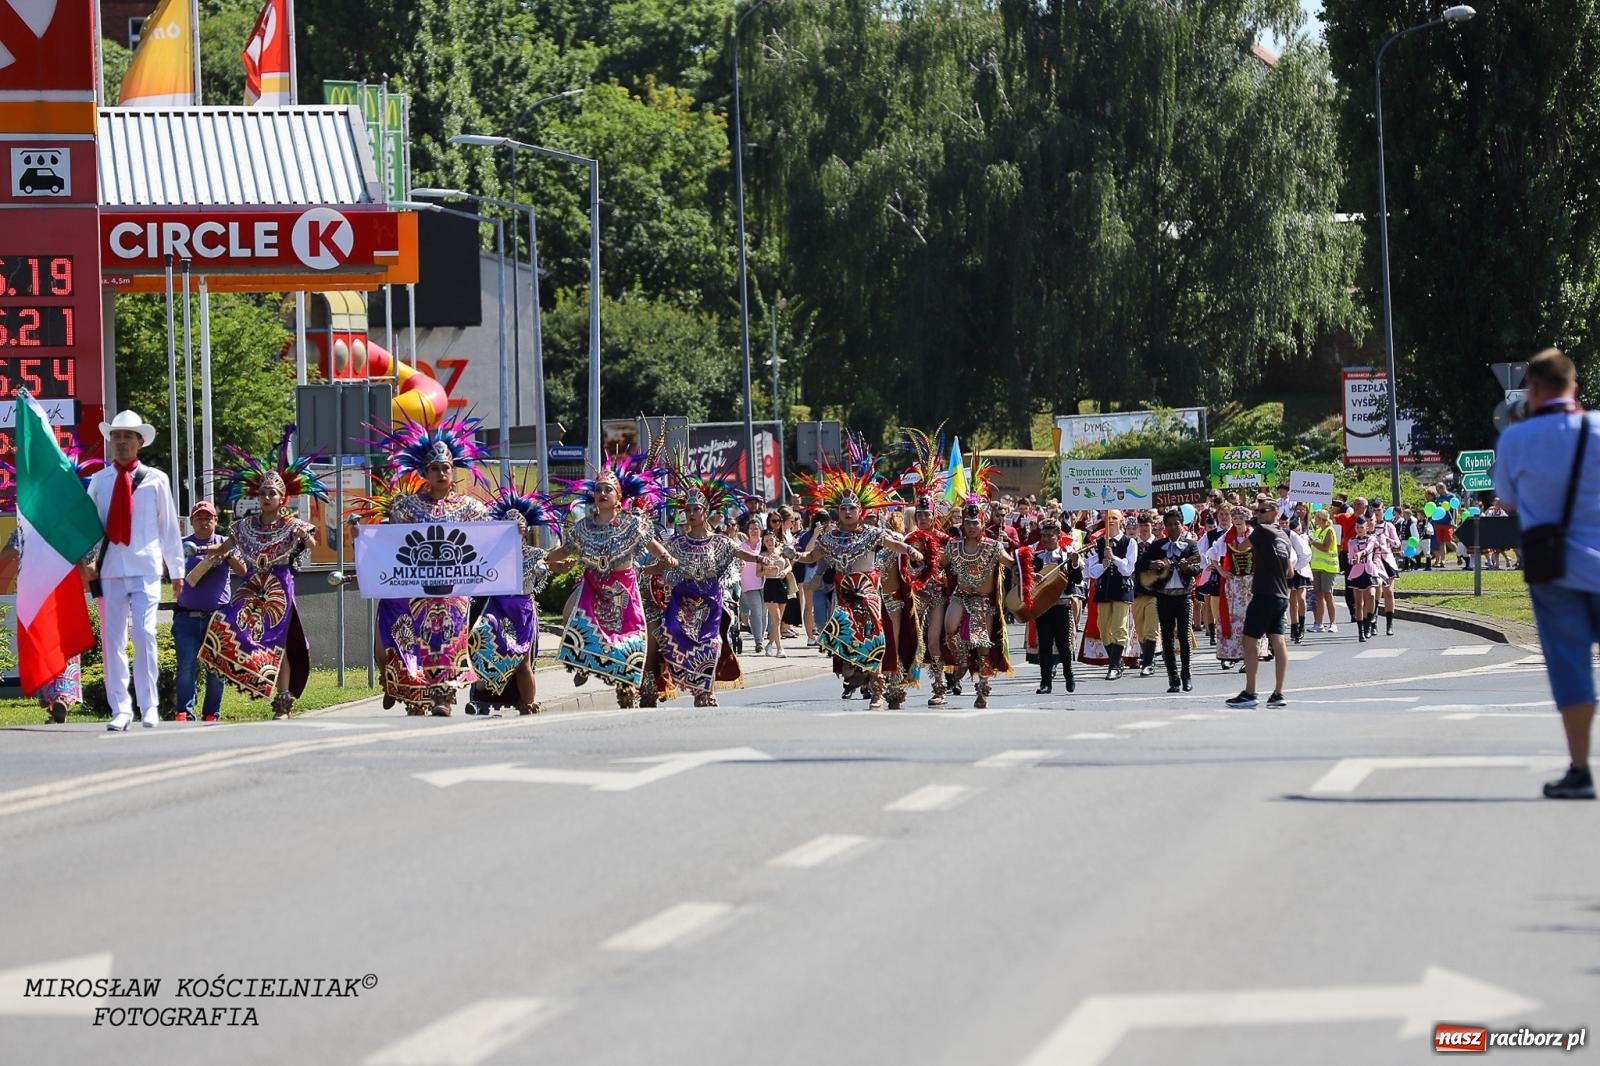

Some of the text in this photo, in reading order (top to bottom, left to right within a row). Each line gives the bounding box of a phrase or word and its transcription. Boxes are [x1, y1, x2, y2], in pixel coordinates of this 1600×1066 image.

[109, 219, 350, 265] CIRCLE K
[0, 258, 72, 296] .19
[1223, 449, 1262, 460] ZARA
[1219, 461, 1267, 471] RACIBÓRZ
[1465, 456, 1492, 471] Rybnik
[1469, 478, 1492, 487] Gliwice
[1156, 492, 1201, 506] Silenzio
[393, 565, 480, 579] MIXCOACALLI
